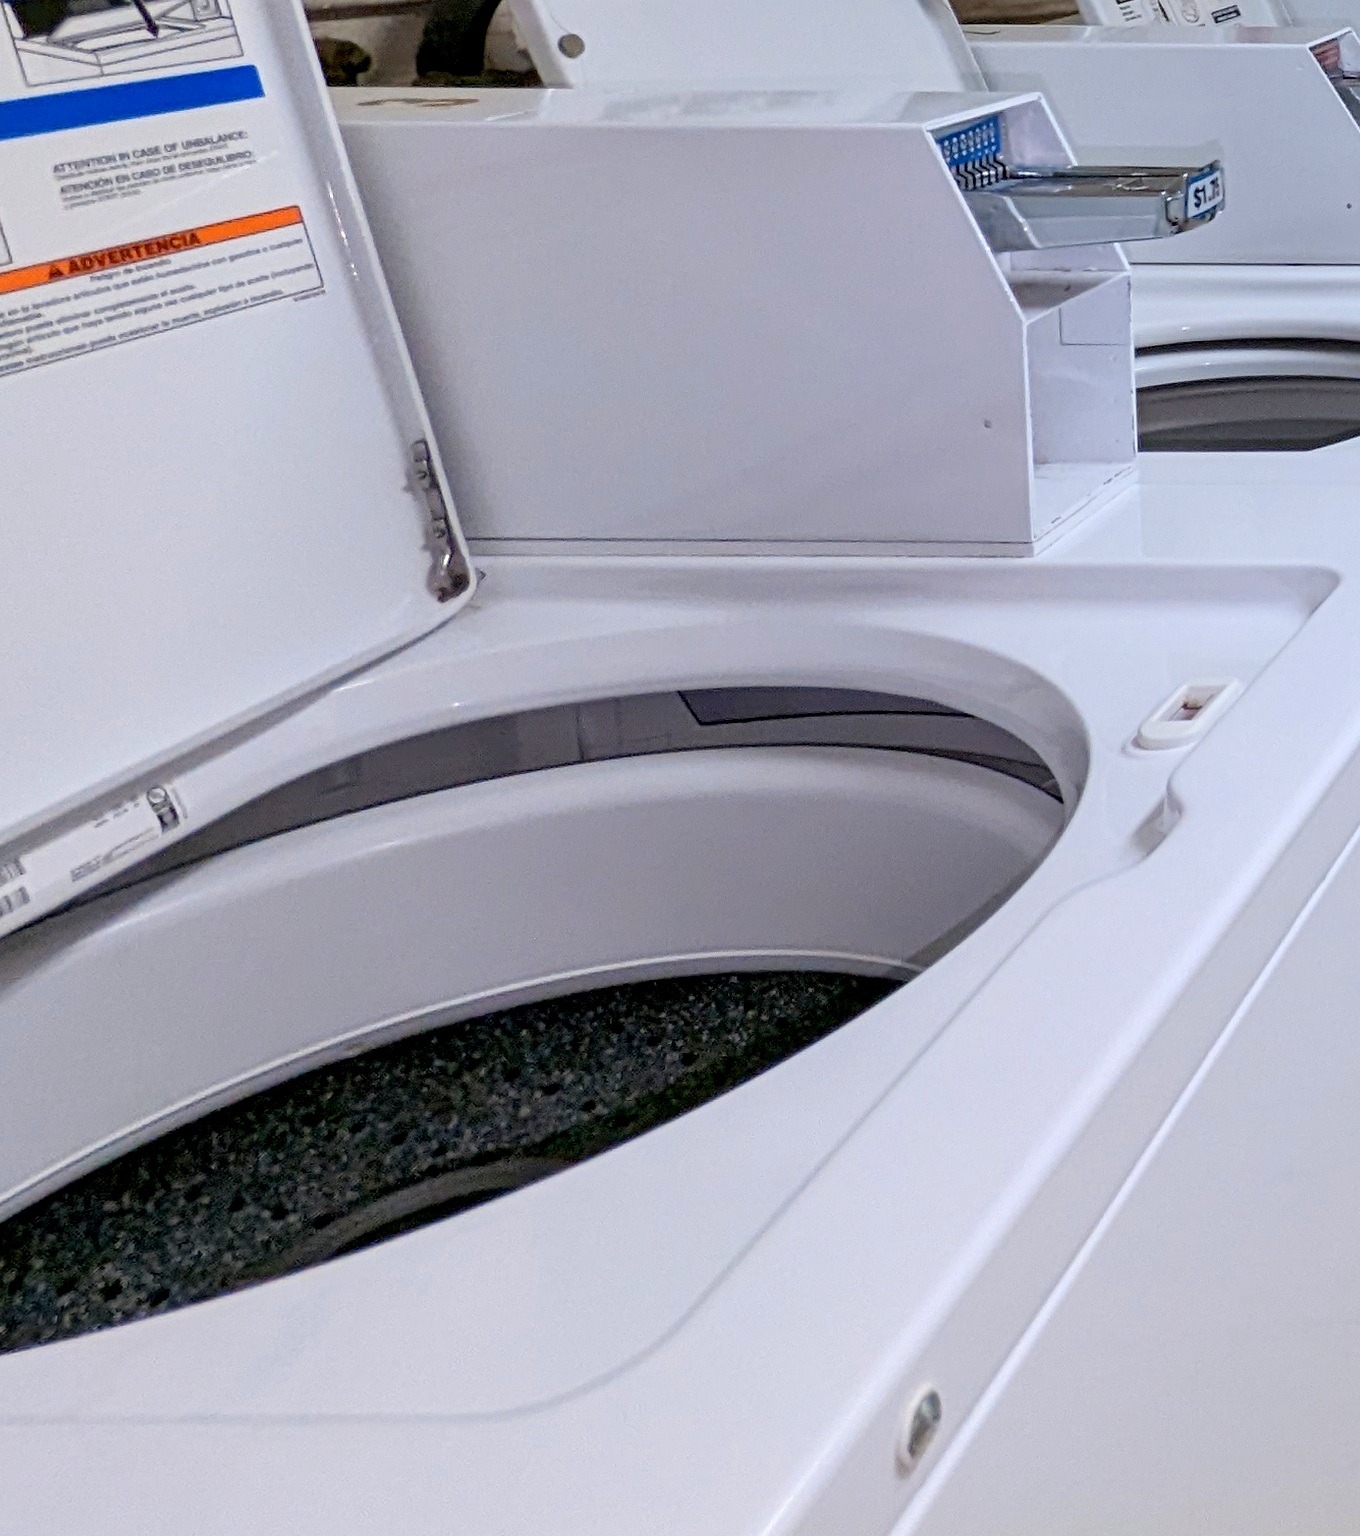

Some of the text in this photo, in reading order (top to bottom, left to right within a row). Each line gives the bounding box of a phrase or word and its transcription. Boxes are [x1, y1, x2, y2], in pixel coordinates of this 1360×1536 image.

[53, 154, 117, 173] ATTENTION
[118, 151, 130, 162] IN
[132, 145, 161, 159] CASE
[163, 142, 179, 153] OF
[68, 232, 200, 274] ADVERTENCIA
